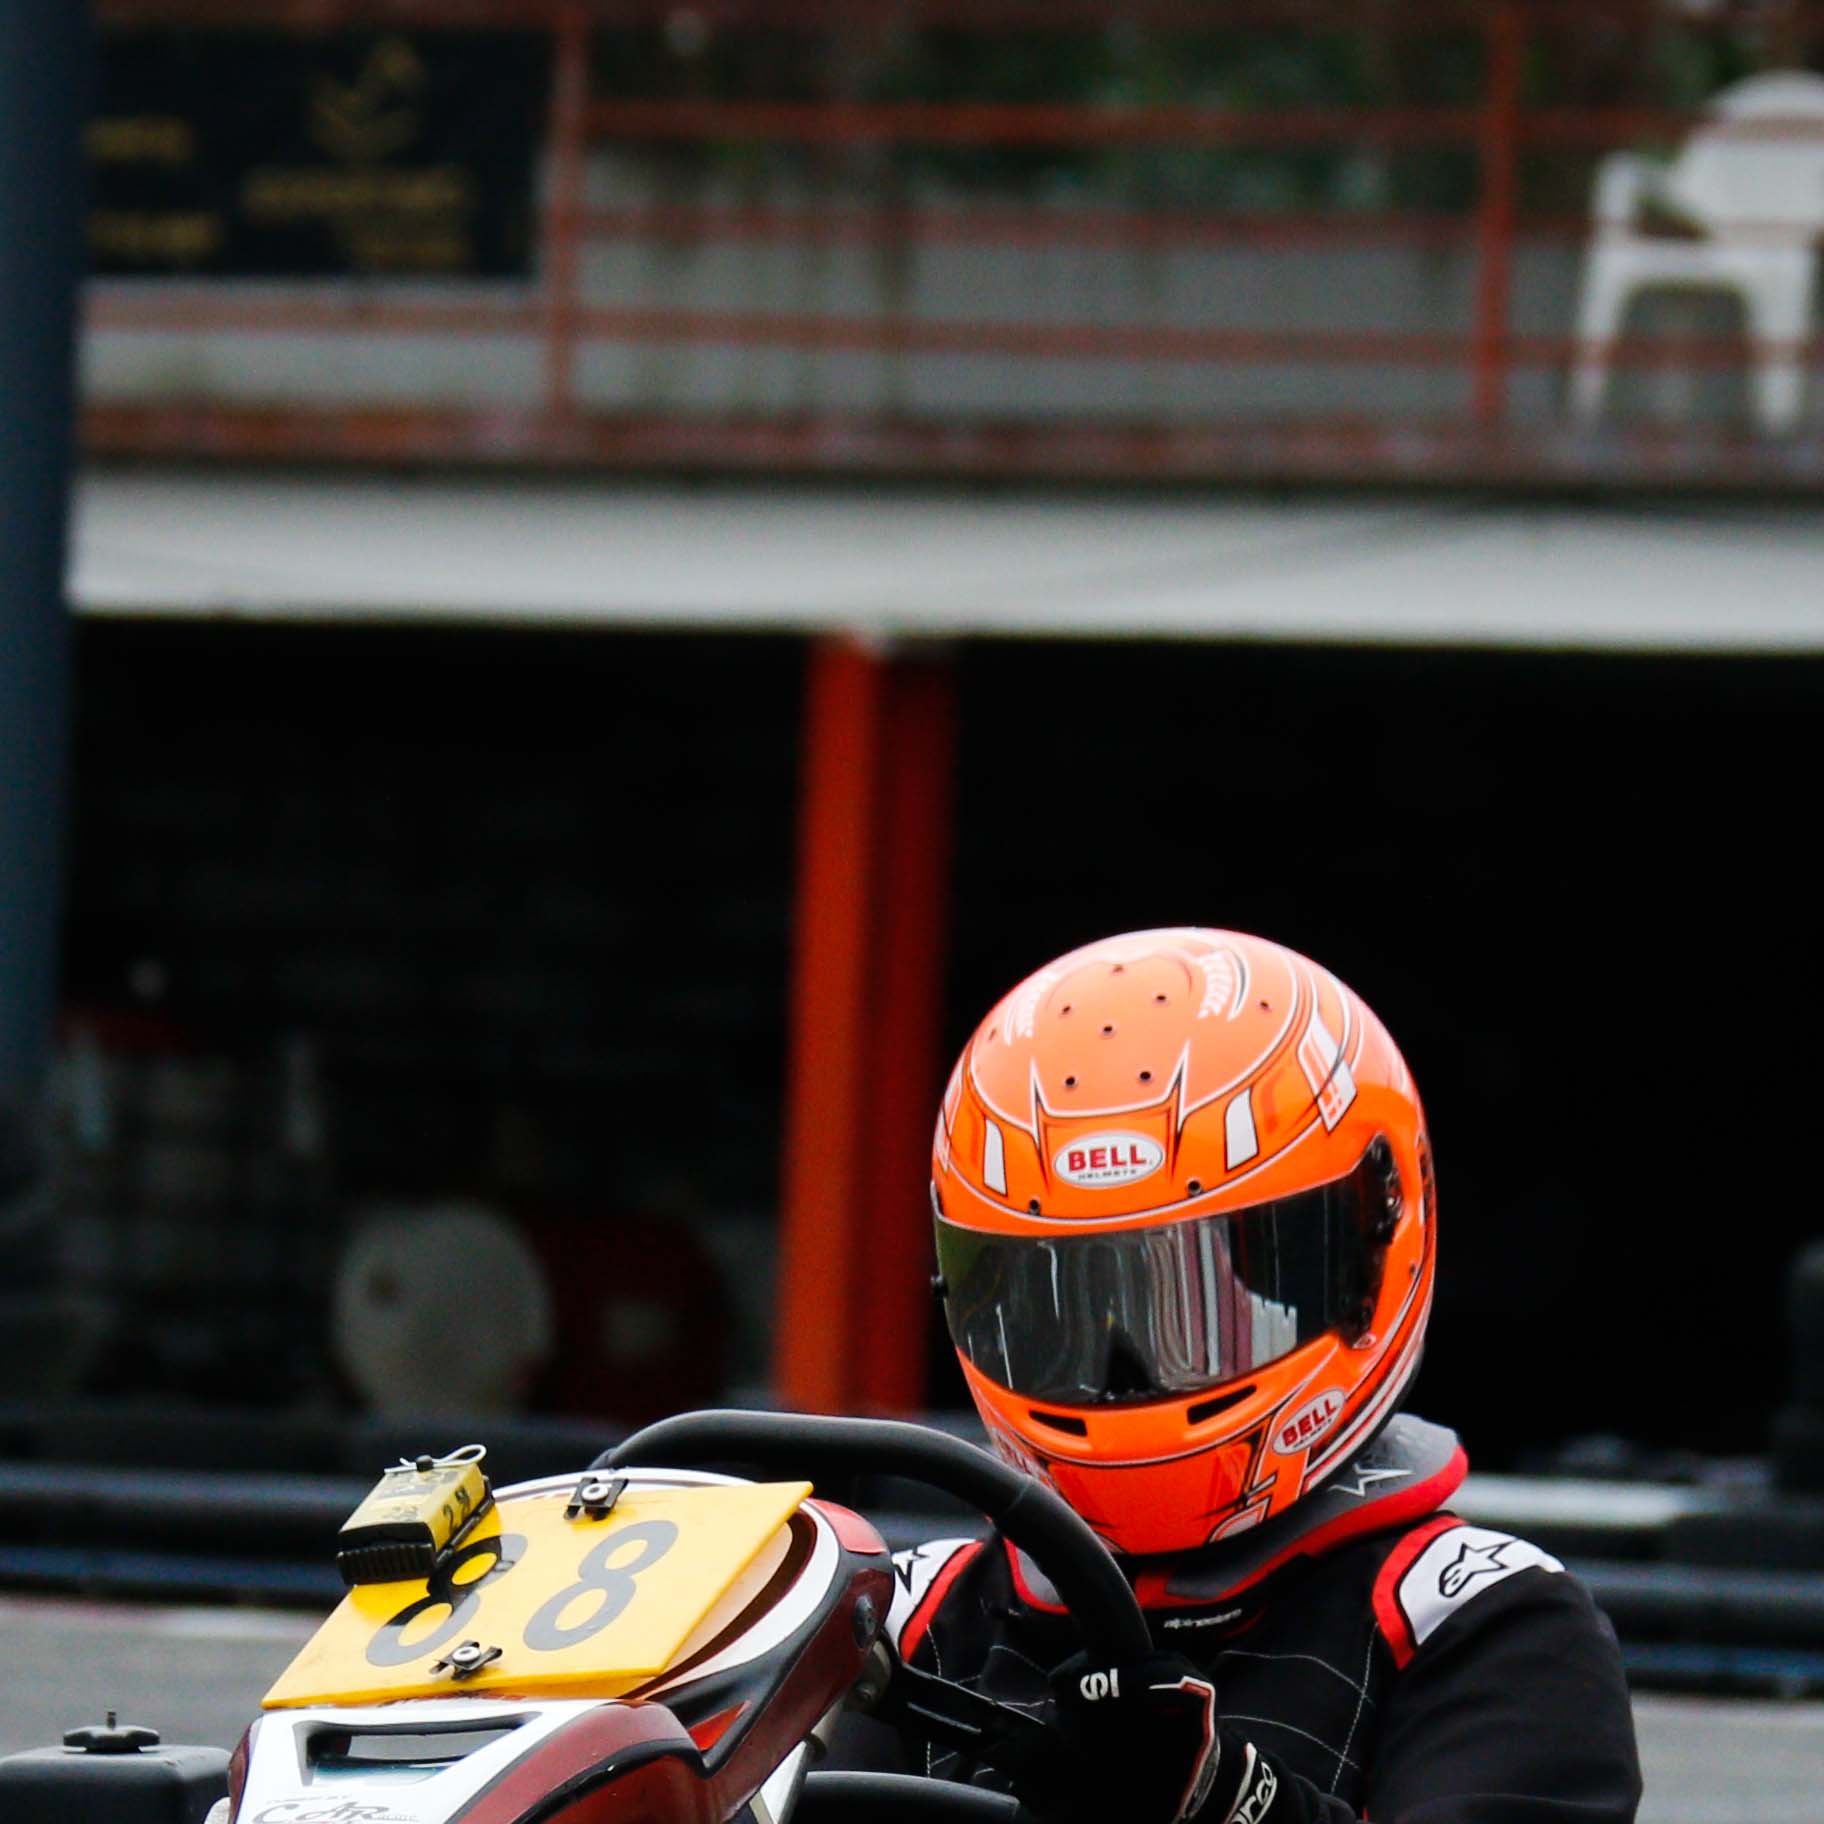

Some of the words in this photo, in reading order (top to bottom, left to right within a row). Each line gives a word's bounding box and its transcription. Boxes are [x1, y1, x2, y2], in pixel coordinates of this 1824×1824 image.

[1068, 1144, 1147, 1172] BELL
[1282, 1399, 1338, 1448] BELL
[365, 1519, 678, 1668] 88
